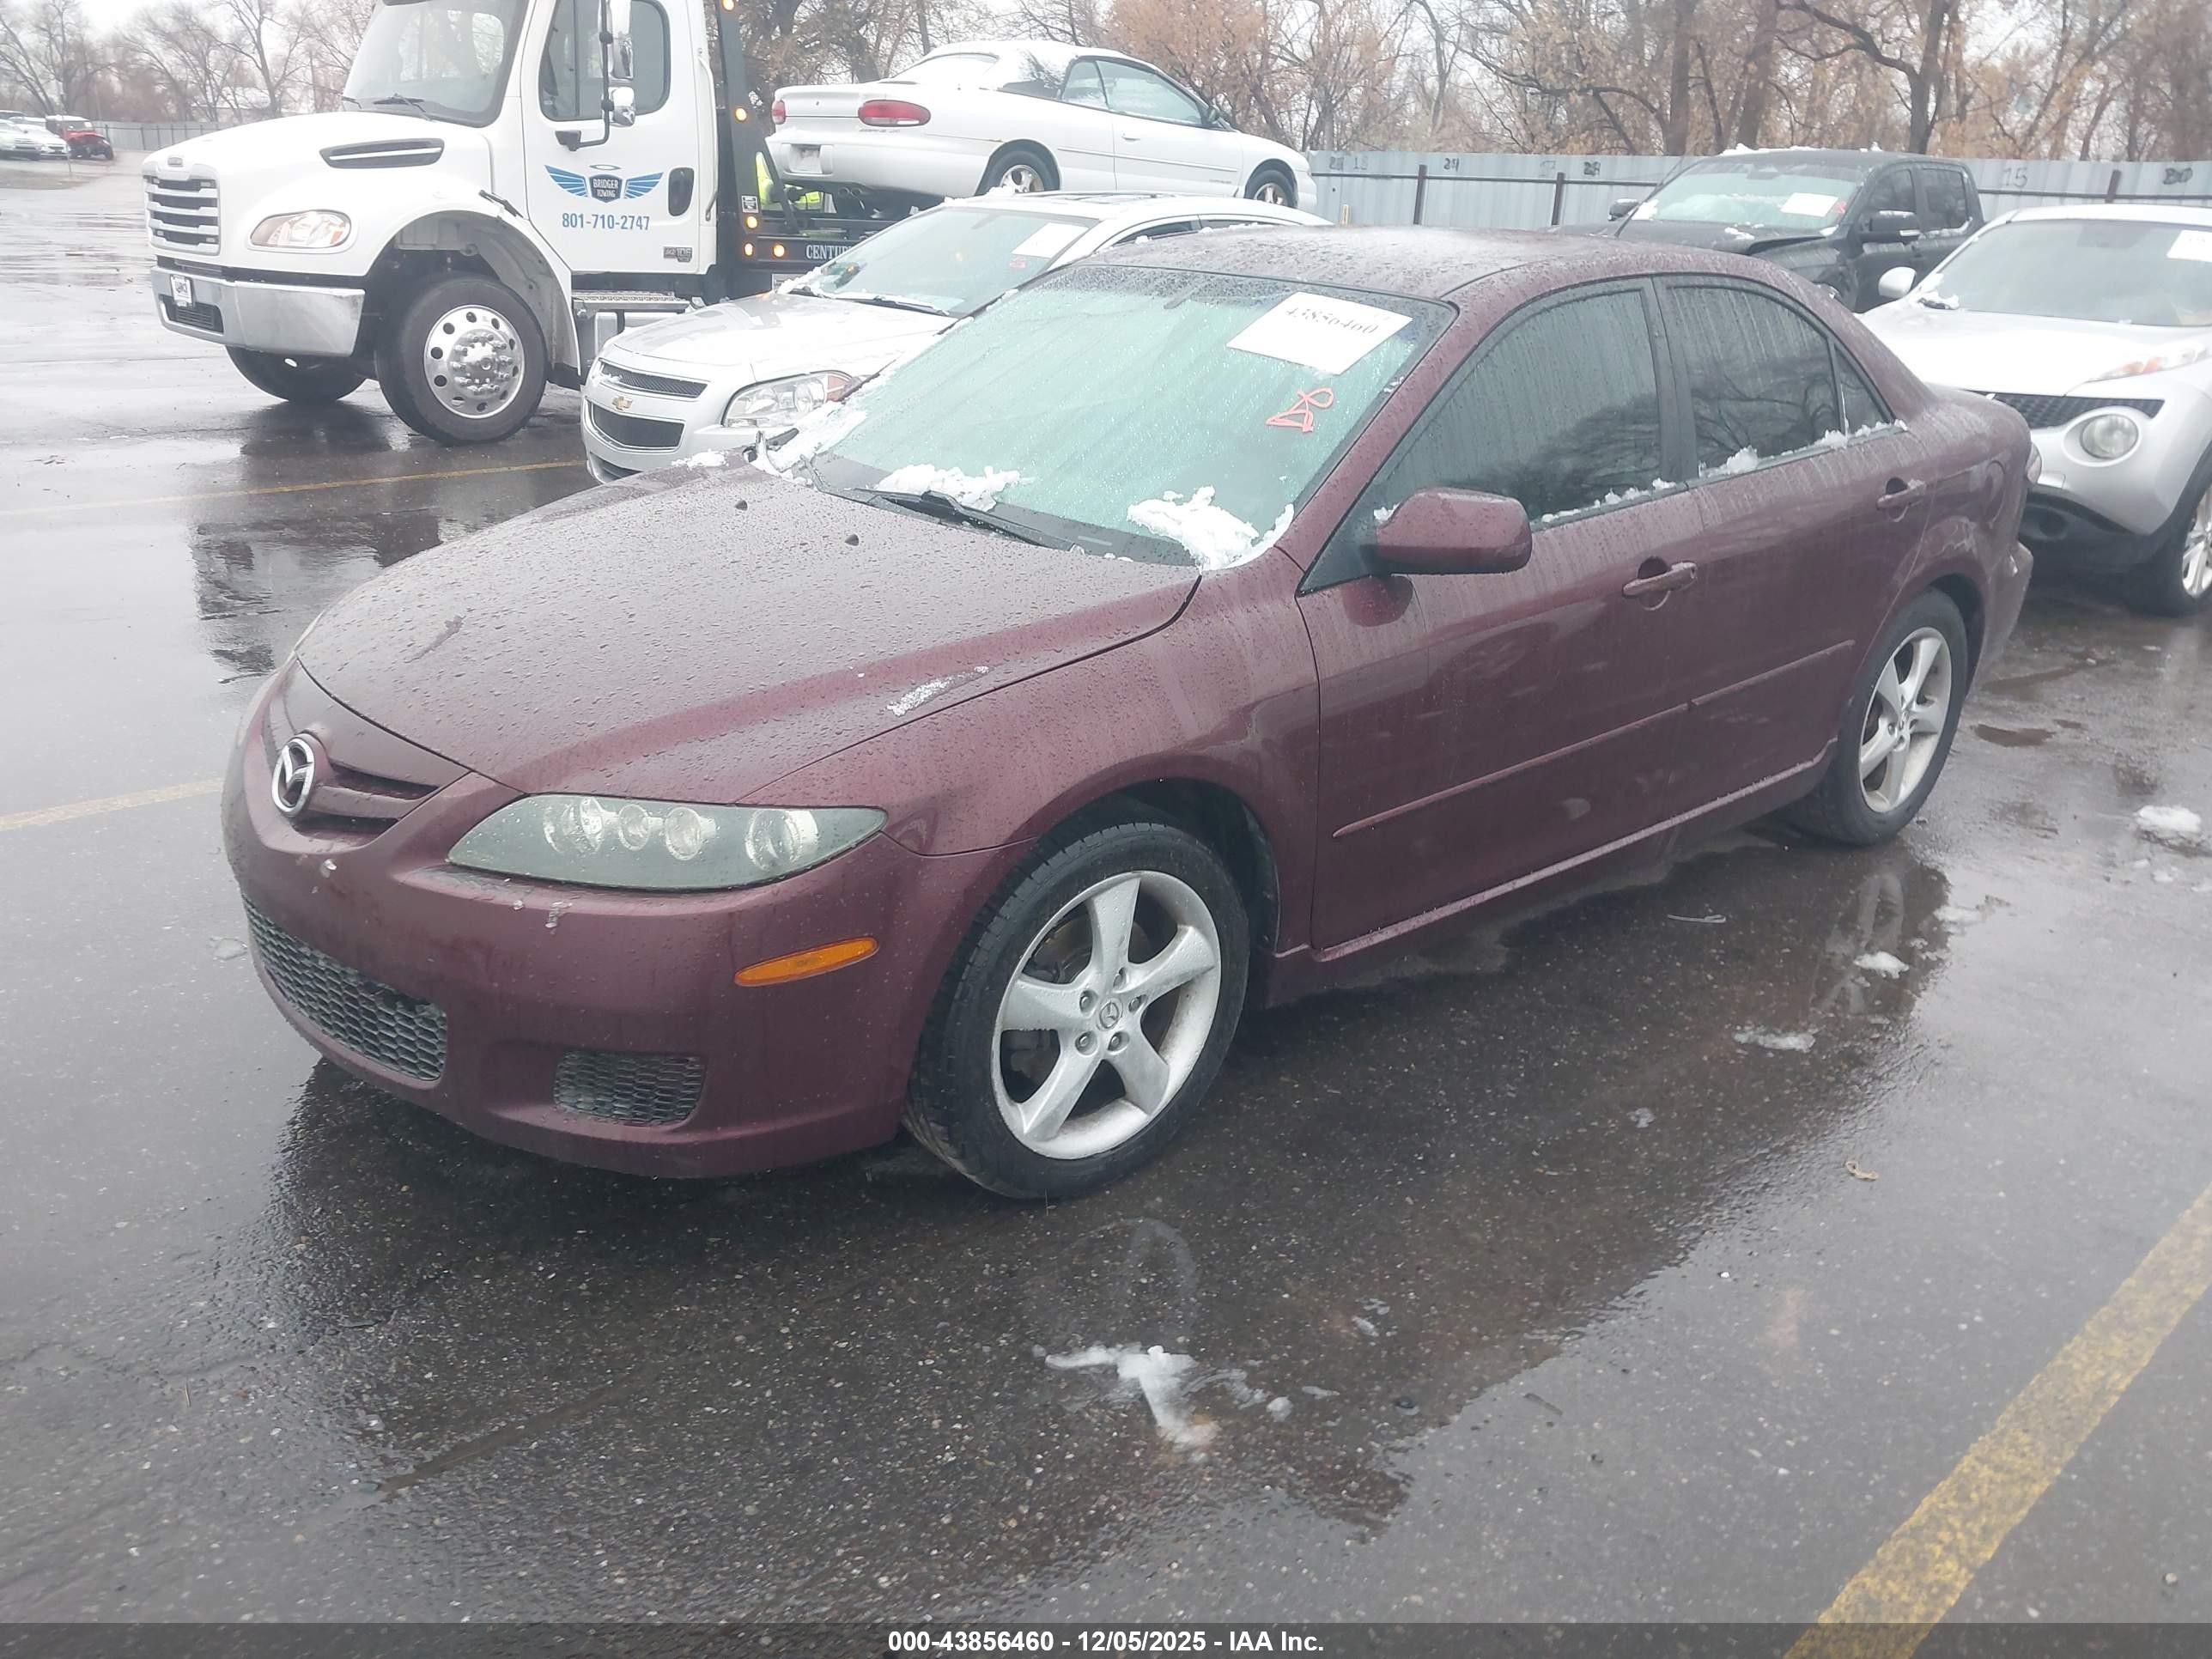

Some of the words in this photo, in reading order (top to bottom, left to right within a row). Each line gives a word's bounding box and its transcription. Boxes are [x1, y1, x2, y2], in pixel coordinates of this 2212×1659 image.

[592, 178, 619, 189] BRIDGER
[2002, 167, 2028, 188] 15
[597, 189, 616, 198] TOWING
[562, 213, 650, 231] 801-710-2747
